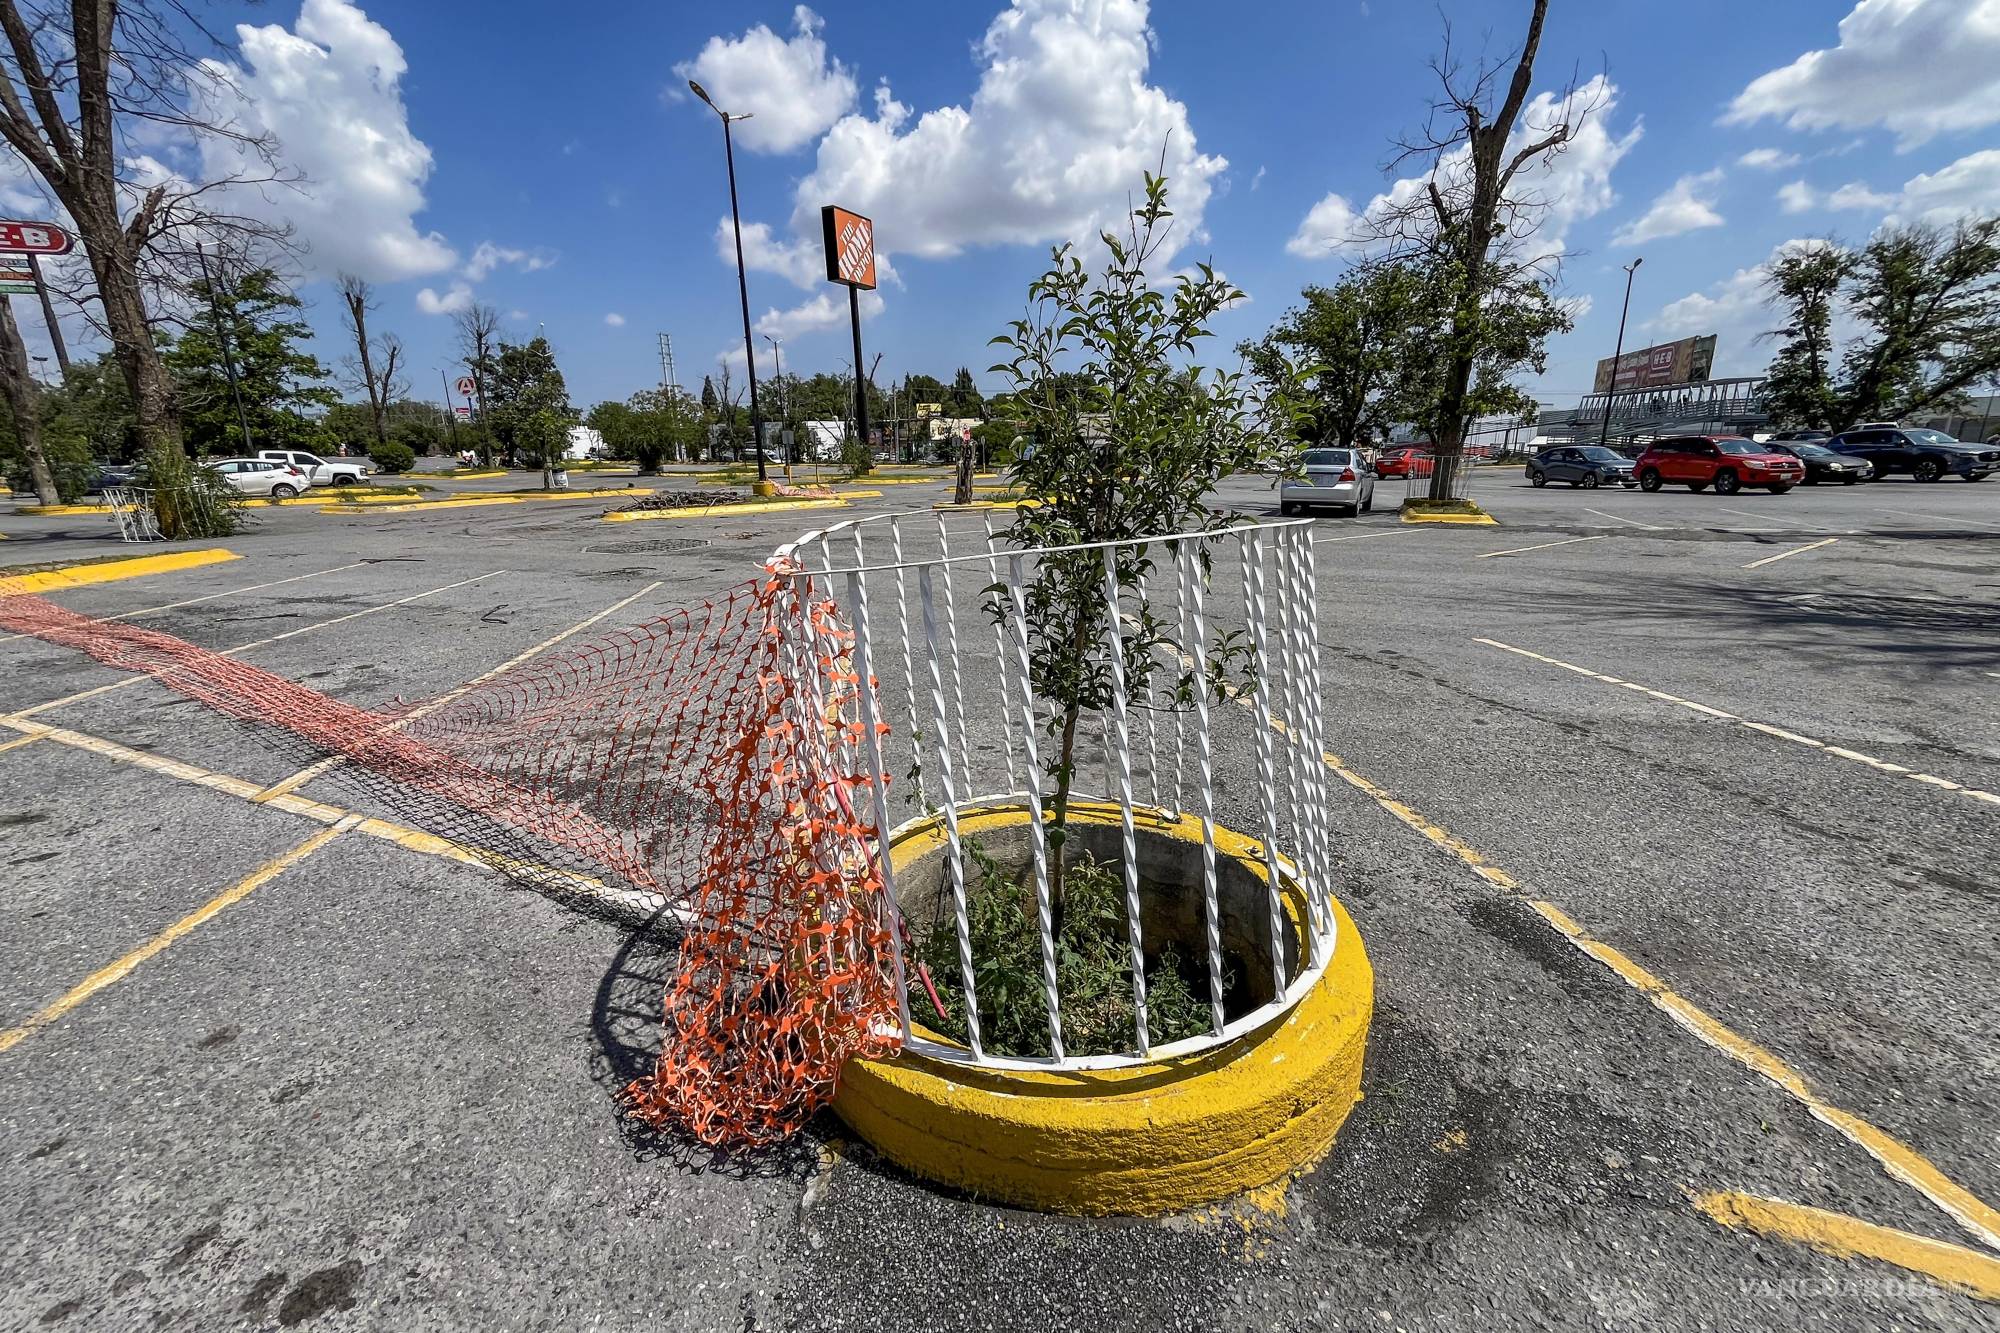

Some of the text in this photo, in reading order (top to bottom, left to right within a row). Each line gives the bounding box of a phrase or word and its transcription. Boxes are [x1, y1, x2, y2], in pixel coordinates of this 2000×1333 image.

[839, 219, 872, 281] HOME
[840, 220, 855, 246] THE
[853, 244, 874, 283] DEPOT
